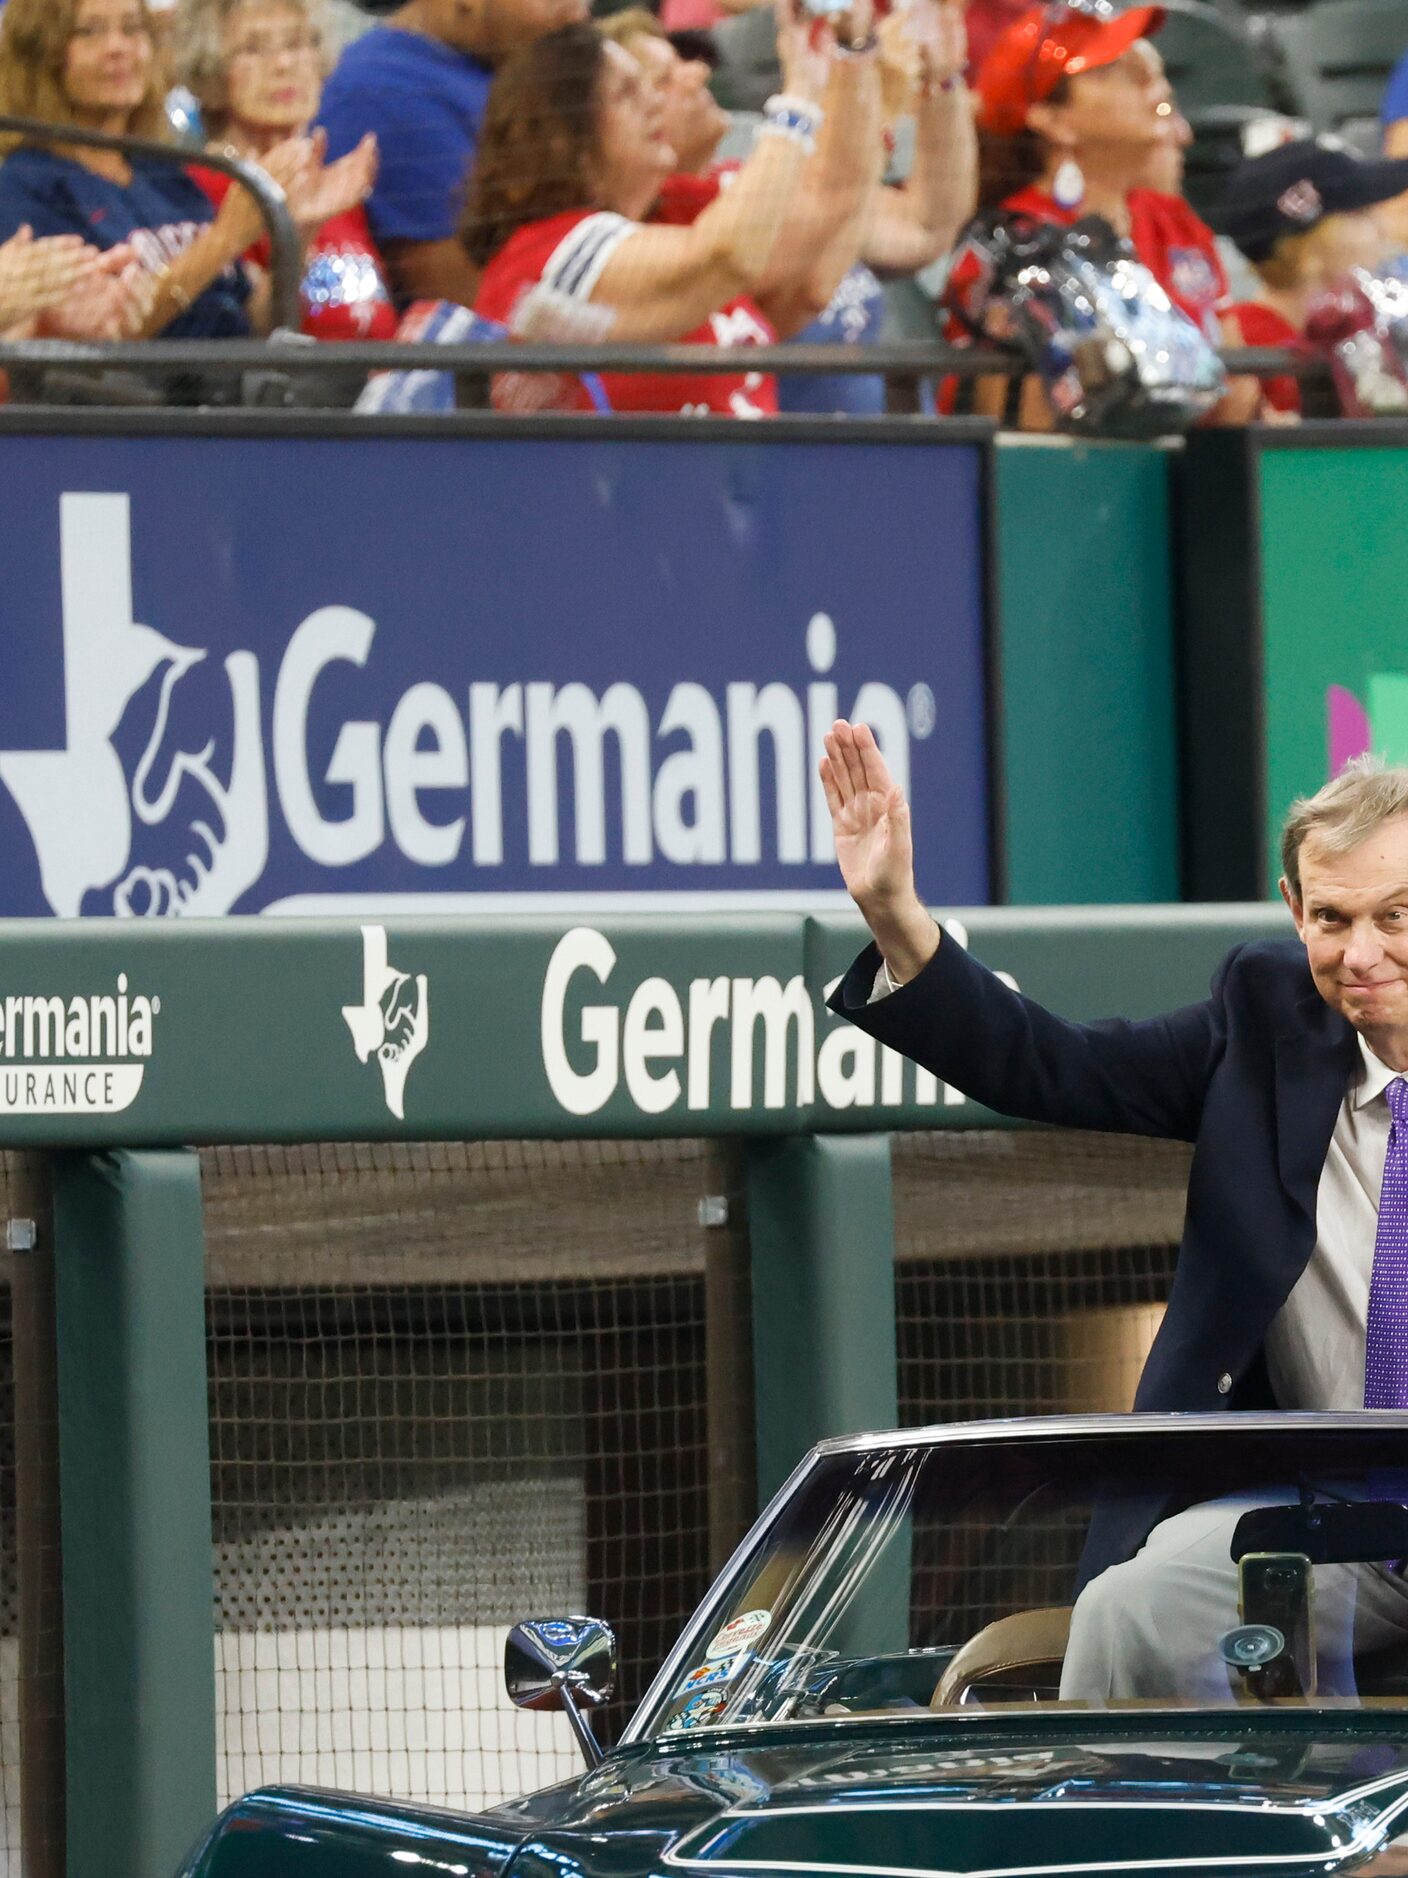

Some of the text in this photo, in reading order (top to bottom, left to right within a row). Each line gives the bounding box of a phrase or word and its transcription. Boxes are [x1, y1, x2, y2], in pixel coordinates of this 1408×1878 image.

[0, 972, 152, 1058] rmania
[541, 918, 1022, 1116] Germa
[5, 1071, 115, 1106] URANCE
[685, 1669, 729, 1689] NCRS
